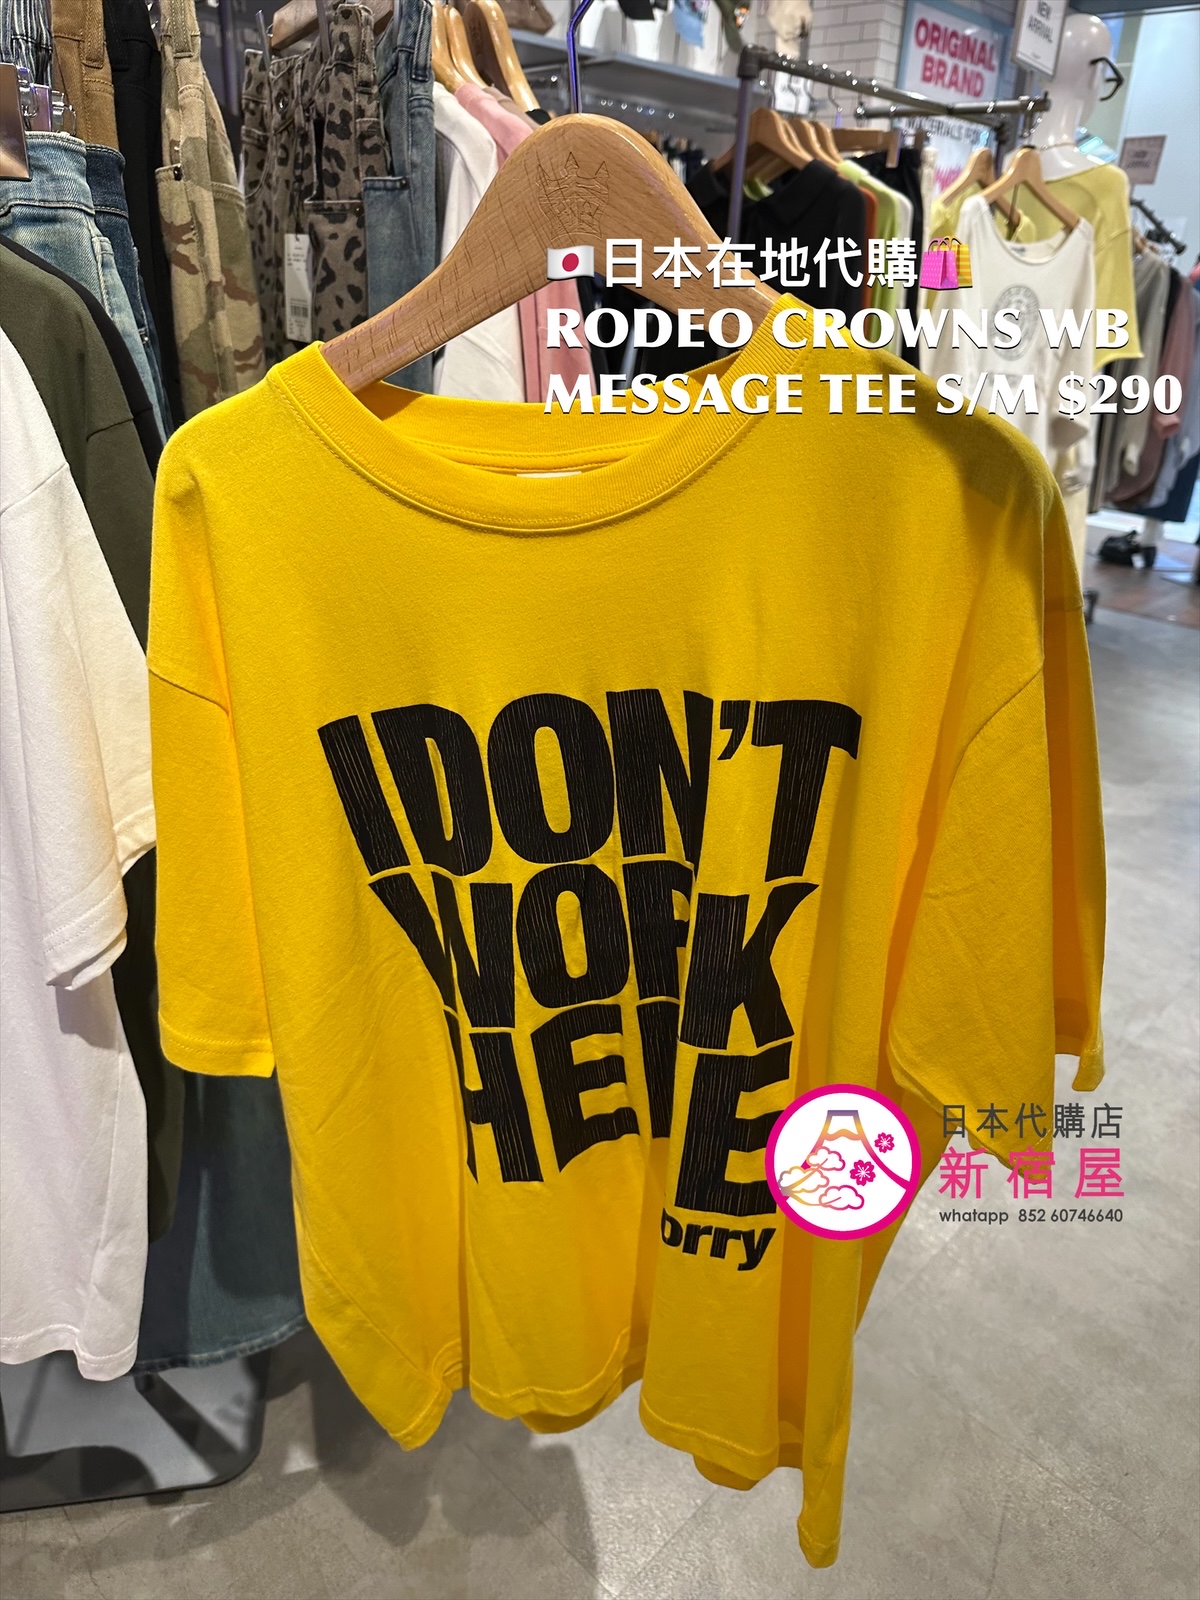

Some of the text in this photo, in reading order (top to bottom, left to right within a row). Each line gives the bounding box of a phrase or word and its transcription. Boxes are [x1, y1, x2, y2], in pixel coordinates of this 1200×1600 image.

[915, 18, 996, 72] ORIGINAL
[921, 55, 985, 98] BRAND
[317, 688, 862, 883] I DON'T
[368, 860, 820, 1050] WORK
[660, 1207, 777, 1271] orry
